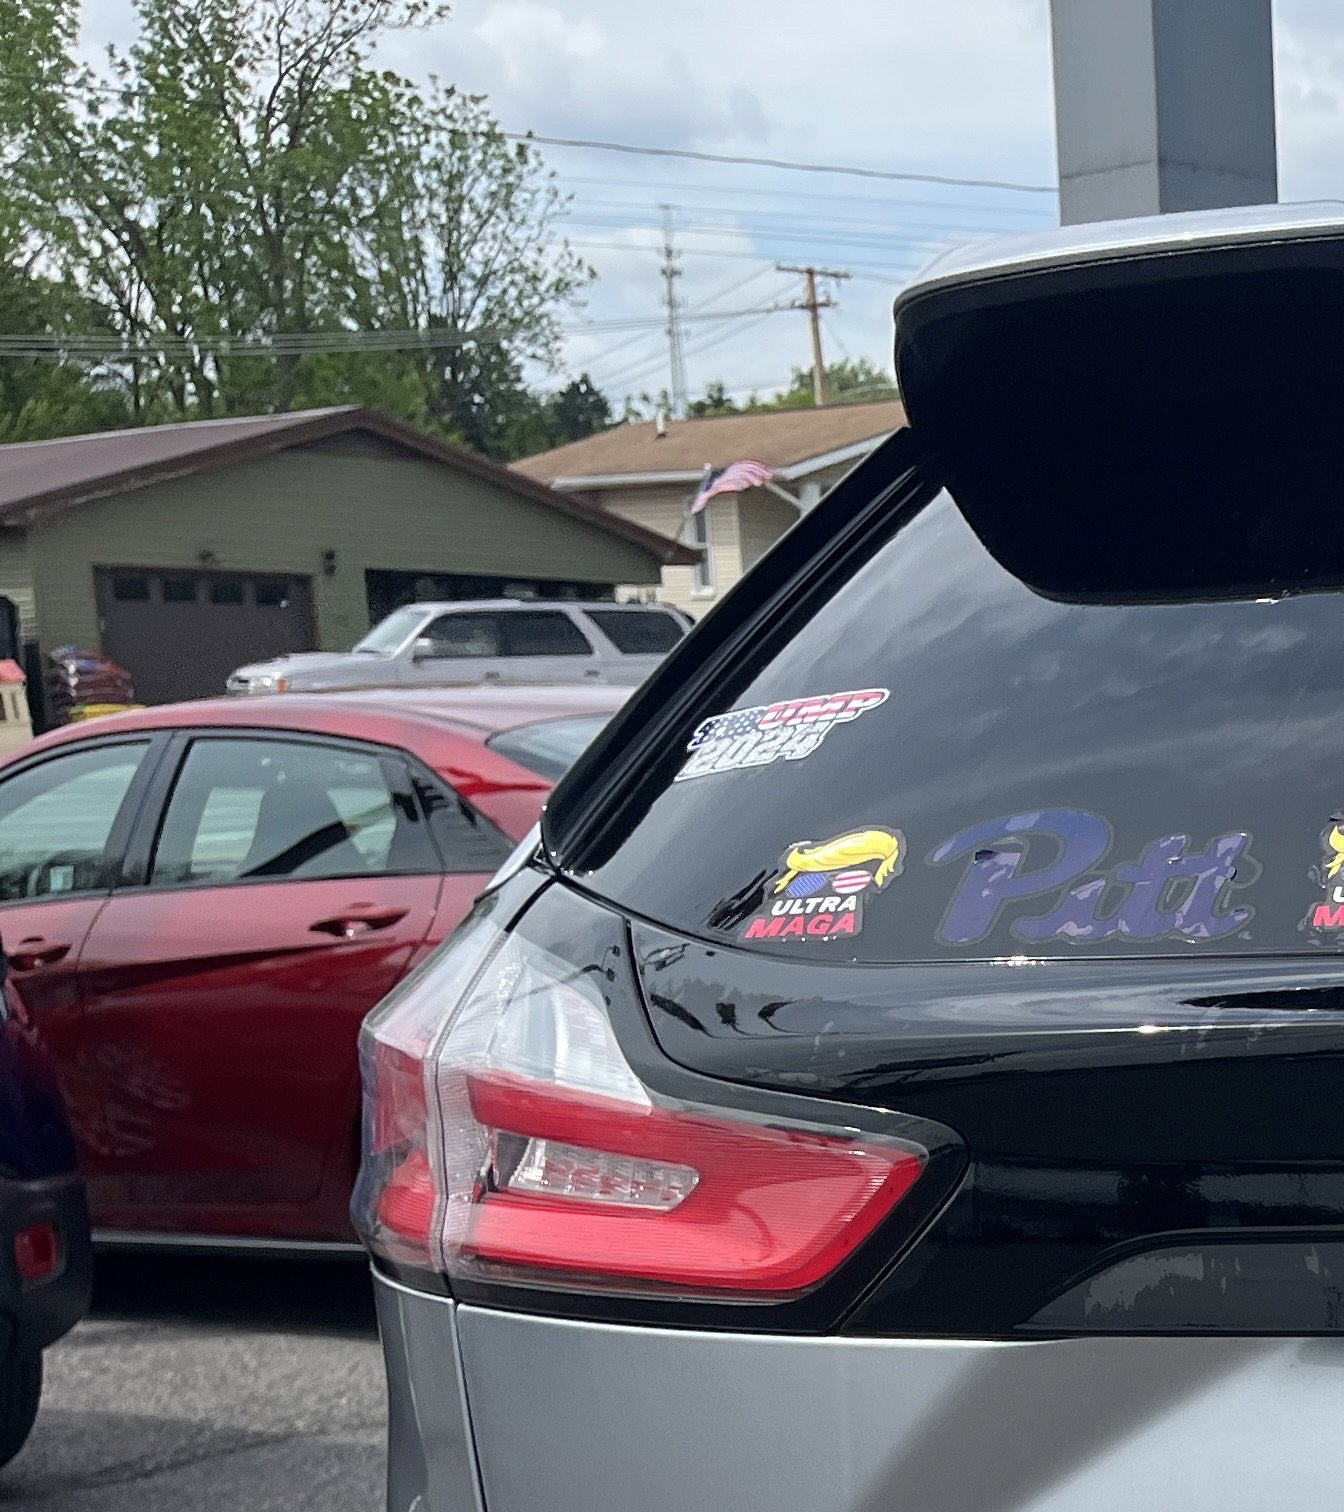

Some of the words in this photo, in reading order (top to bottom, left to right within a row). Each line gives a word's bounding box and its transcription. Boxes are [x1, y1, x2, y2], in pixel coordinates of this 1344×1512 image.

[678, 720, 834, 778] 2024
[930, 808, 1248, 943] Pitt
[744, 911, 856, 939] MAGA
[770, 894, 858, 916] ULTRA
